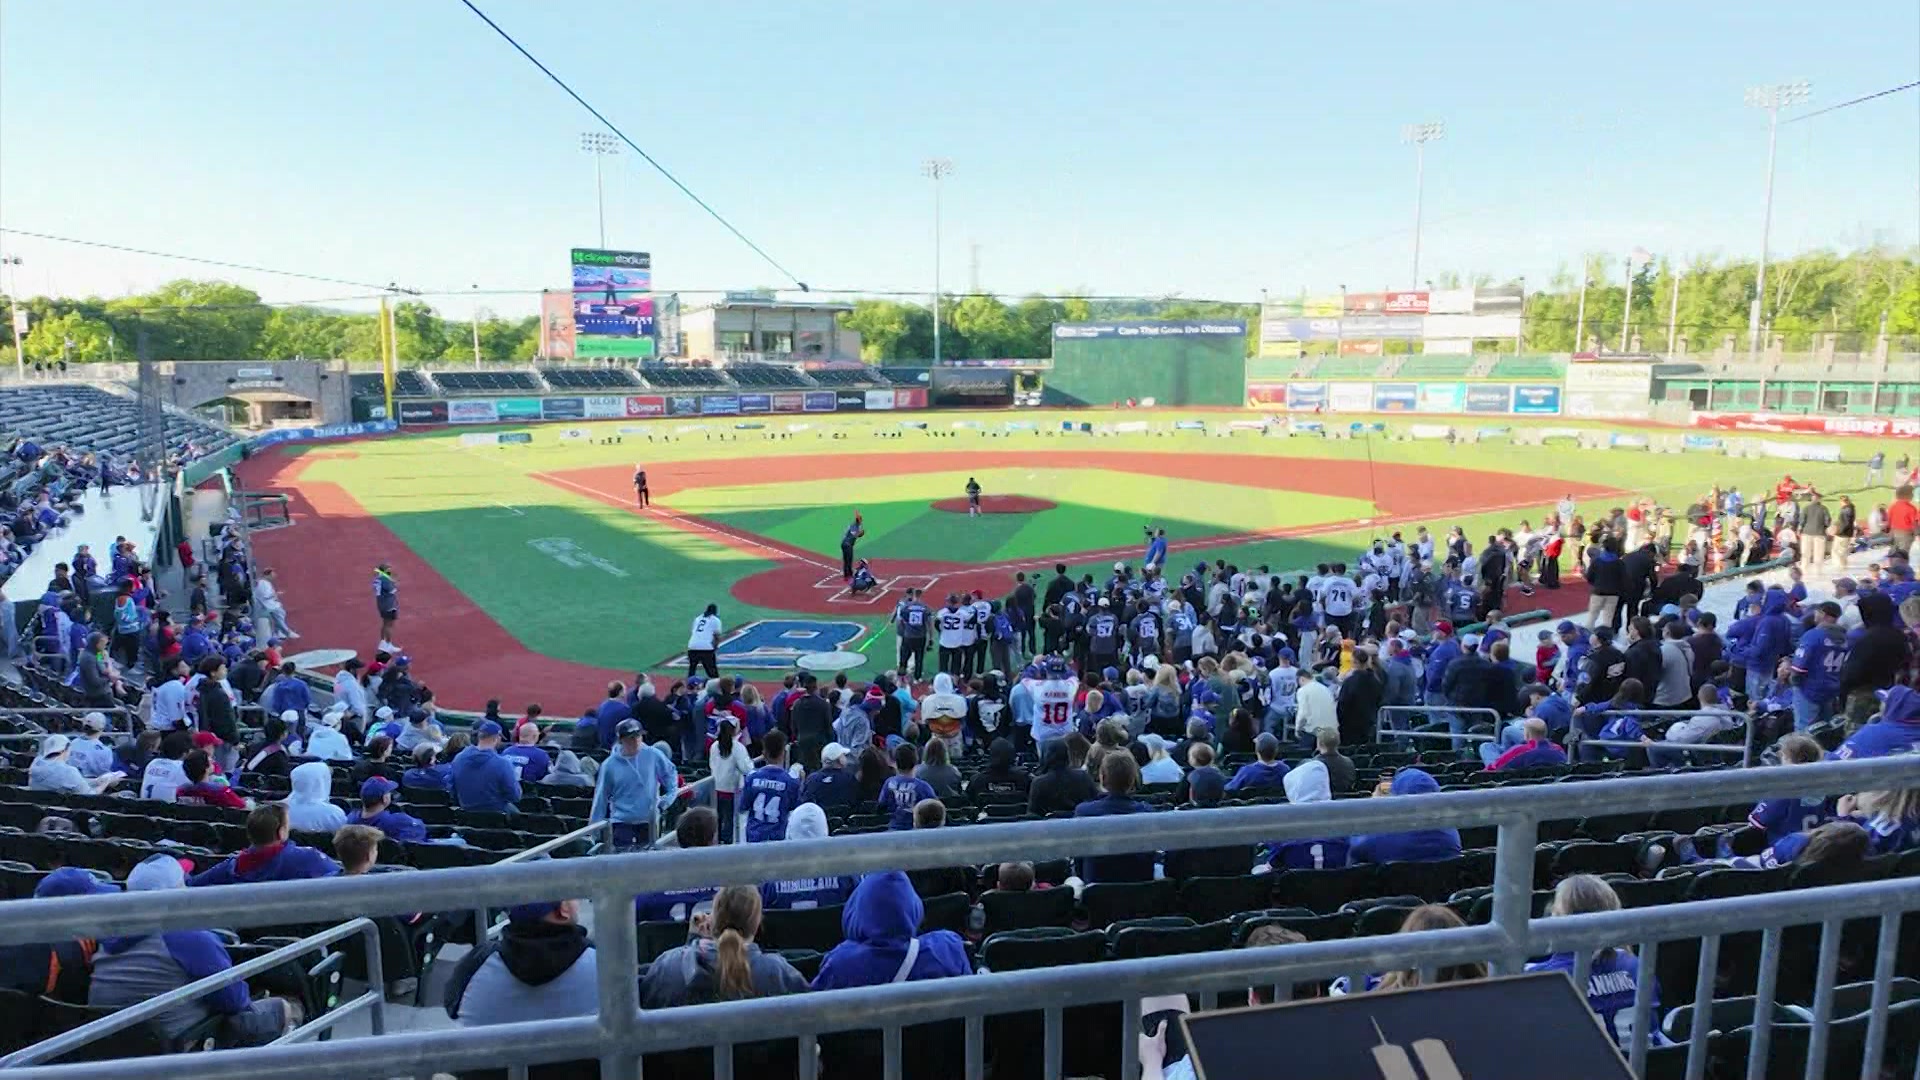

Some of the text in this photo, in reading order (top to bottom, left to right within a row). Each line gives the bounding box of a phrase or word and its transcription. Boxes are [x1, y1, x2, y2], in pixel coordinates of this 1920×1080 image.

[1043, 702, 1069, 724] 10
[753, 792, 781, 824] 44
[1587, 970, 1637, 998] ANNING
